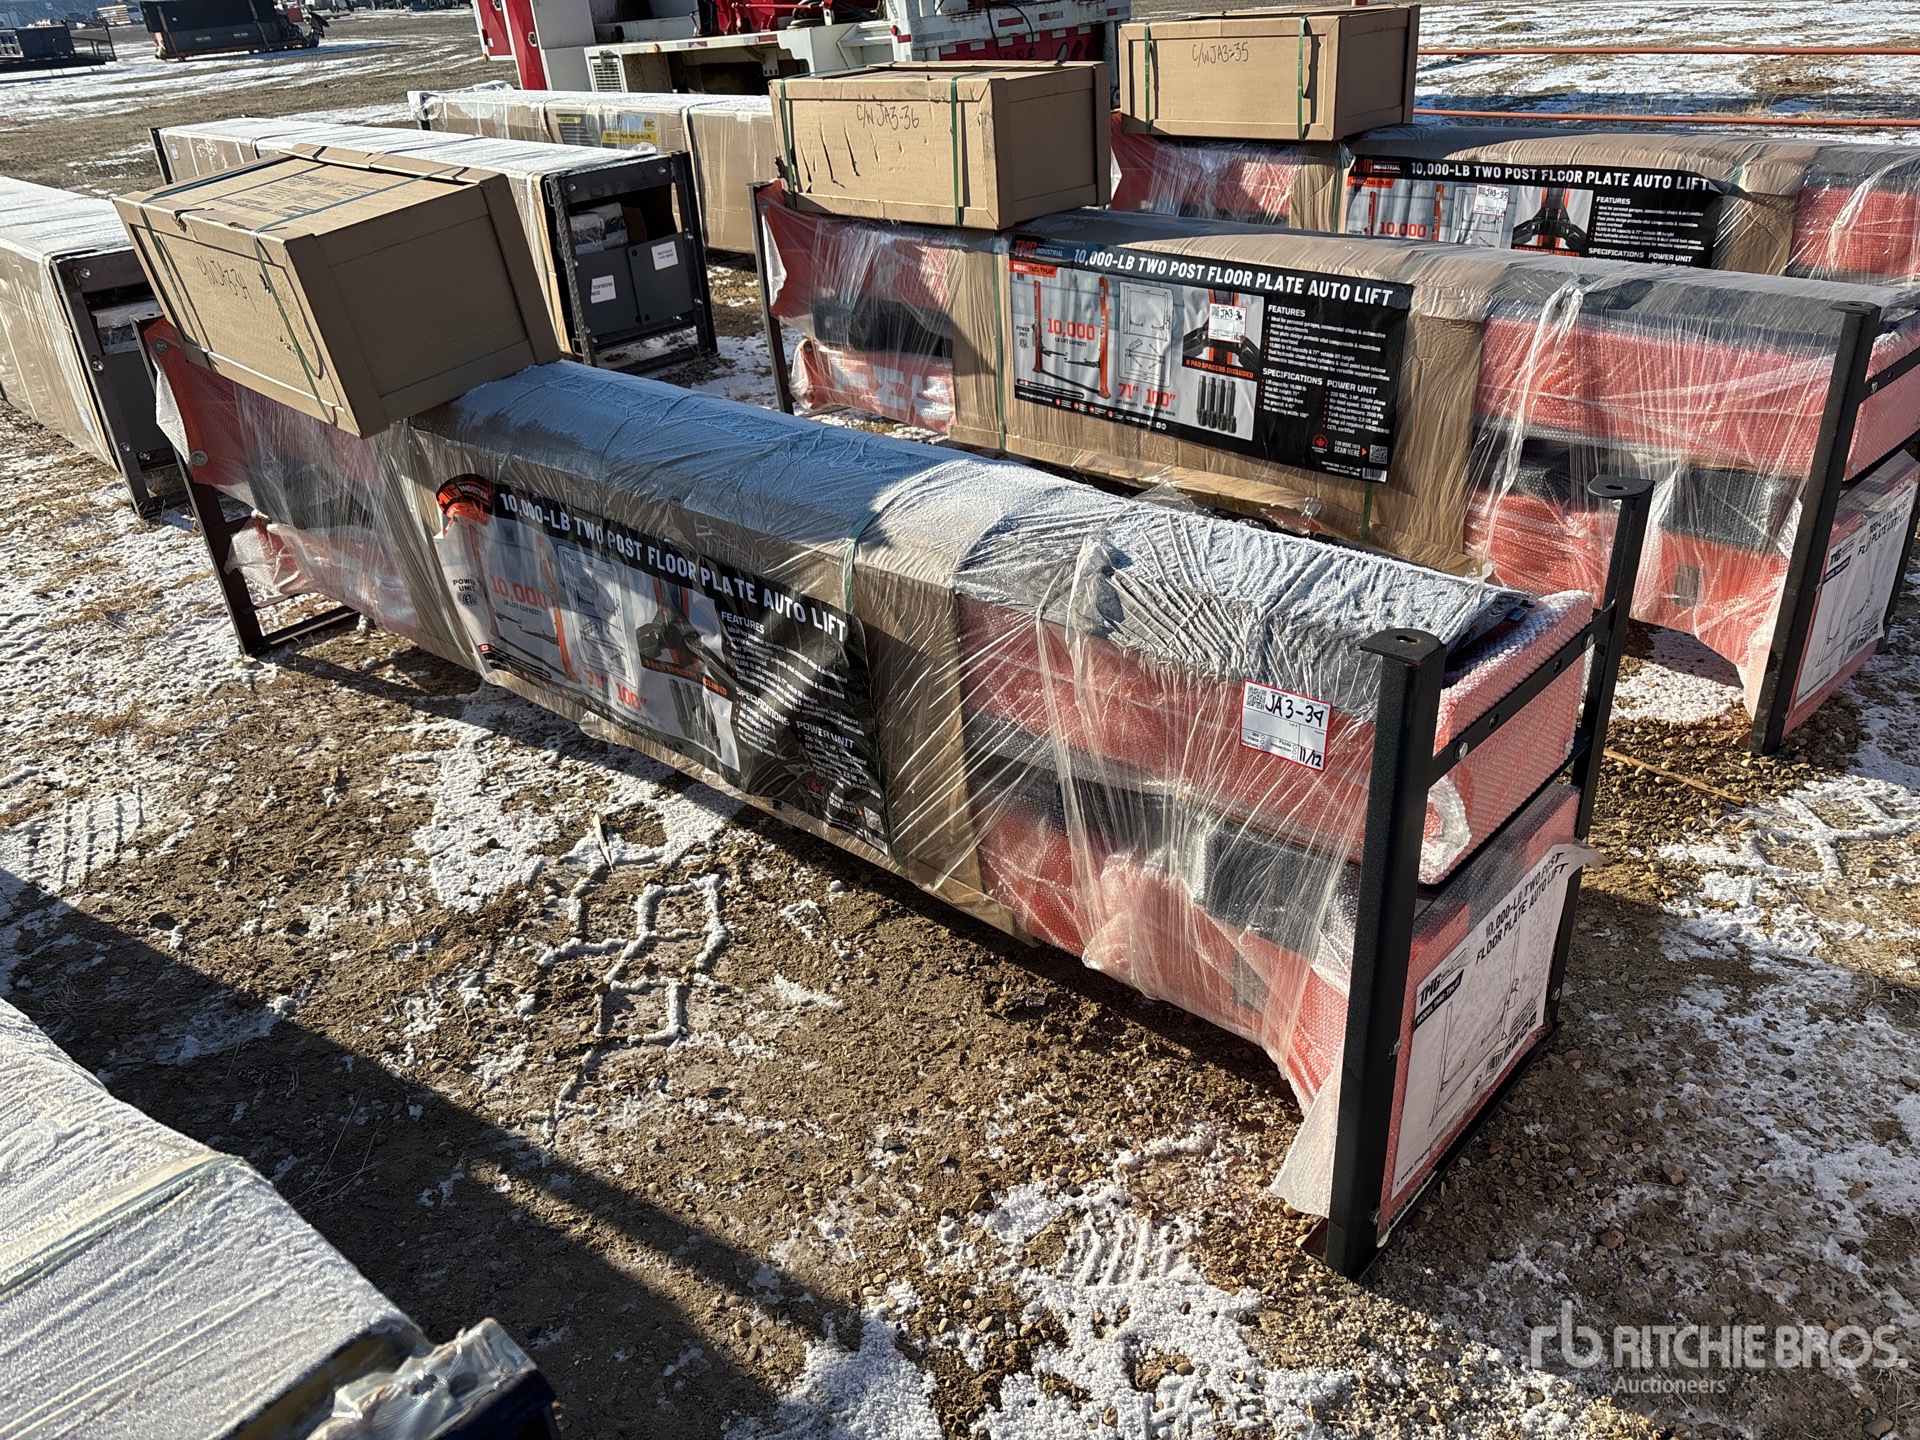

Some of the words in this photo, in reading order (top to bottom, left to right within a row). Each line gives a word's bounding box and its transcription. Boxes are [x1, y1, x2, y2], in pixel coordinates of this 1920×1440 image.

[876, 102, 919, 130] JA3-36
[1411, 162, 1470, 176] 10,000-LB
[1475, 166, 1501, 178] TWO
[1505, 168, 1537, 181] POST
[1541, 169, 1582, 184] FLOOR
[1586, 172, 1630, 187] PLATE
[1633, 174, 1672, 189] AUTO
[1677, 176, 1709, 191] LIFT
[1596, 196, 1630, 204] FEATURES
[1379, 221, 1426, 237] 10,000
[1014, 240, 1037, 258] TMG
[1036, 247, 1063, 257] INDUSTRIAL
[1588, 247, 1644, 258] SPECIFICATIONS
[1013, 264, 1029, 272] MODEL
[1074, 249, 1135, 271] 10,000-LB
[1139, 257, 1167, 274] TWO
[1169, 262, 1205, 280] POST
[1207, 266, 1253, 287] FLOOR
[1255, 272, 1304, 294] PLATE
[1307, 280, 1350, 300] AUTO
[1354, 286, 1393, 306] LIFT
[1268, 304, 1306, 317] FEATURES
[1016, 325, 1030, 333] POWER
[1047, 318, 1096, 340] 10,000
[1202, 362, 1225, 373] SPACERS
[1226, 367, 1253, 378] INCLUDED
[1262, 368, 1323, 385] SPECIFICATIONS
[1118, 383, 1139, 399] 71"
[1327, 380, 1356, 392] POWER
[1357, 385, 1377, 395] UNIT
[1334, 446, 1347, 455] SCAN
[1348, 448, 1360, 457] HERE
[500, 493, 571, 531] 10,000-LB
[573, 517, 604, 544] TWO
[607, 529, 642, 560] POST
[648, 546, 697, 582] FLOOR
[700, 566, 757, 604] PLATE
[763, 587, 806, 623] AUTO
[811, 607, 846, 642] LIFT
[490, 574, 548, 611] 10,000
[721, 611, 764, 635] FEATURES
[615, 682, 647, 711] 100"
[736, 686, 790, 727] SPECIFICATIONS
[1265, 695, 1324, 727] JA3-34
[796, 720, 830, 739] POWER
[831, 732, 854, 748] UNIT
[1300, 746, 1321, 767] 11/12
[1486, 891, 1522, 938] 10,000-LB
[1524, 871, 1540, 897] TWO
[1541, 852, 1564, 880] POST
[1476, 929, 1502, 965] FLOOR
[1504, 900, 1527, 936] PLATE
[1529, 878, 1546, 909] AUTO
[1547, 863, 1569, 886] LIFT
[1420, 973, 1441, 1006] TMG
